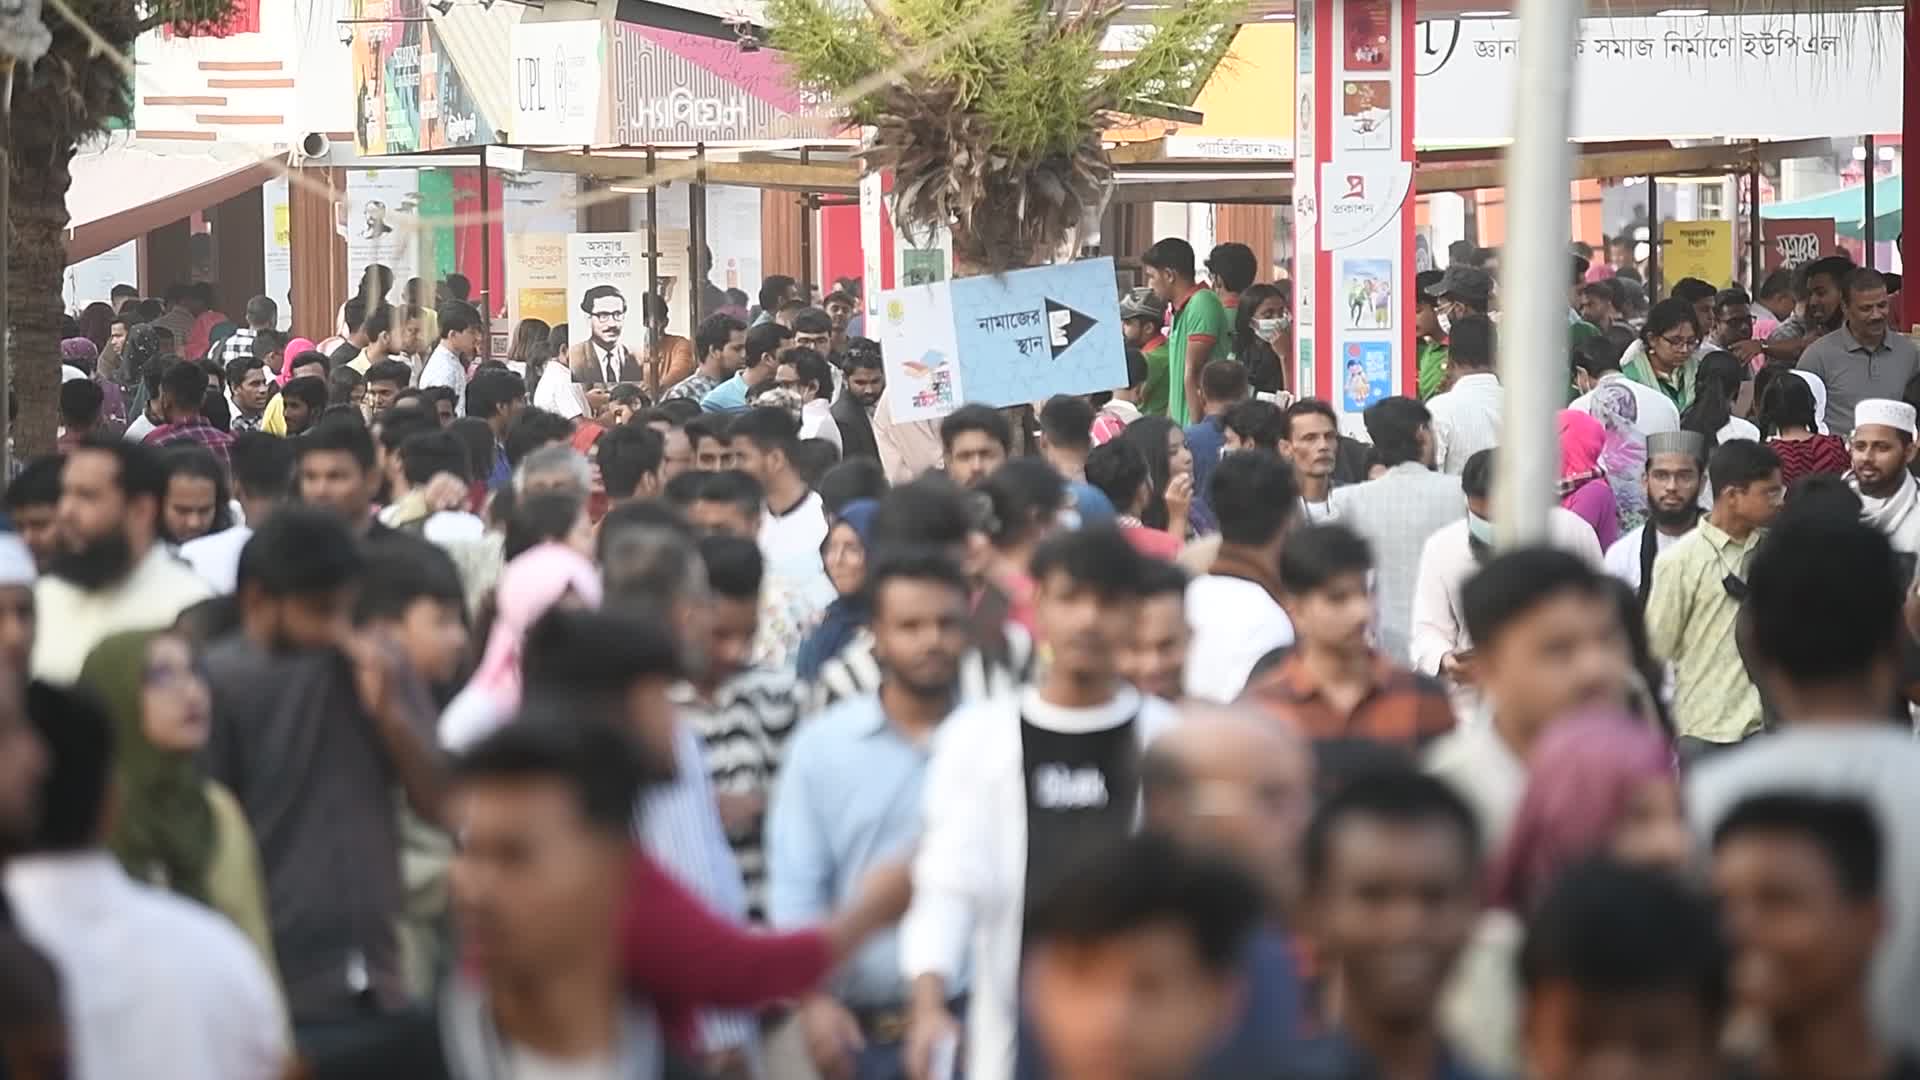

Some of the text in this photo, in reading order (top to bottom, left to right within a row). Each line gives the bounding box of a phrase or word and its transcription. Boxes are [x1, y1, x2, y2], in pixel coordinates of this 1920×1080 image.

[1594, 39, 1655, 60] সমাজ
[1664, 30, 1735, 60] নির্মাণে
[1739, 28, 1842, 60] ইউপিএল
[517, 57, 546, 112] UPL
[586, 240, 622, 251] অসমাপ্ত
[578, 252, 631, 267] আত্মজীবনী
[976, 309, 1041, 335] নামাজের
[1015, 336, 1043, 359] স্থান
